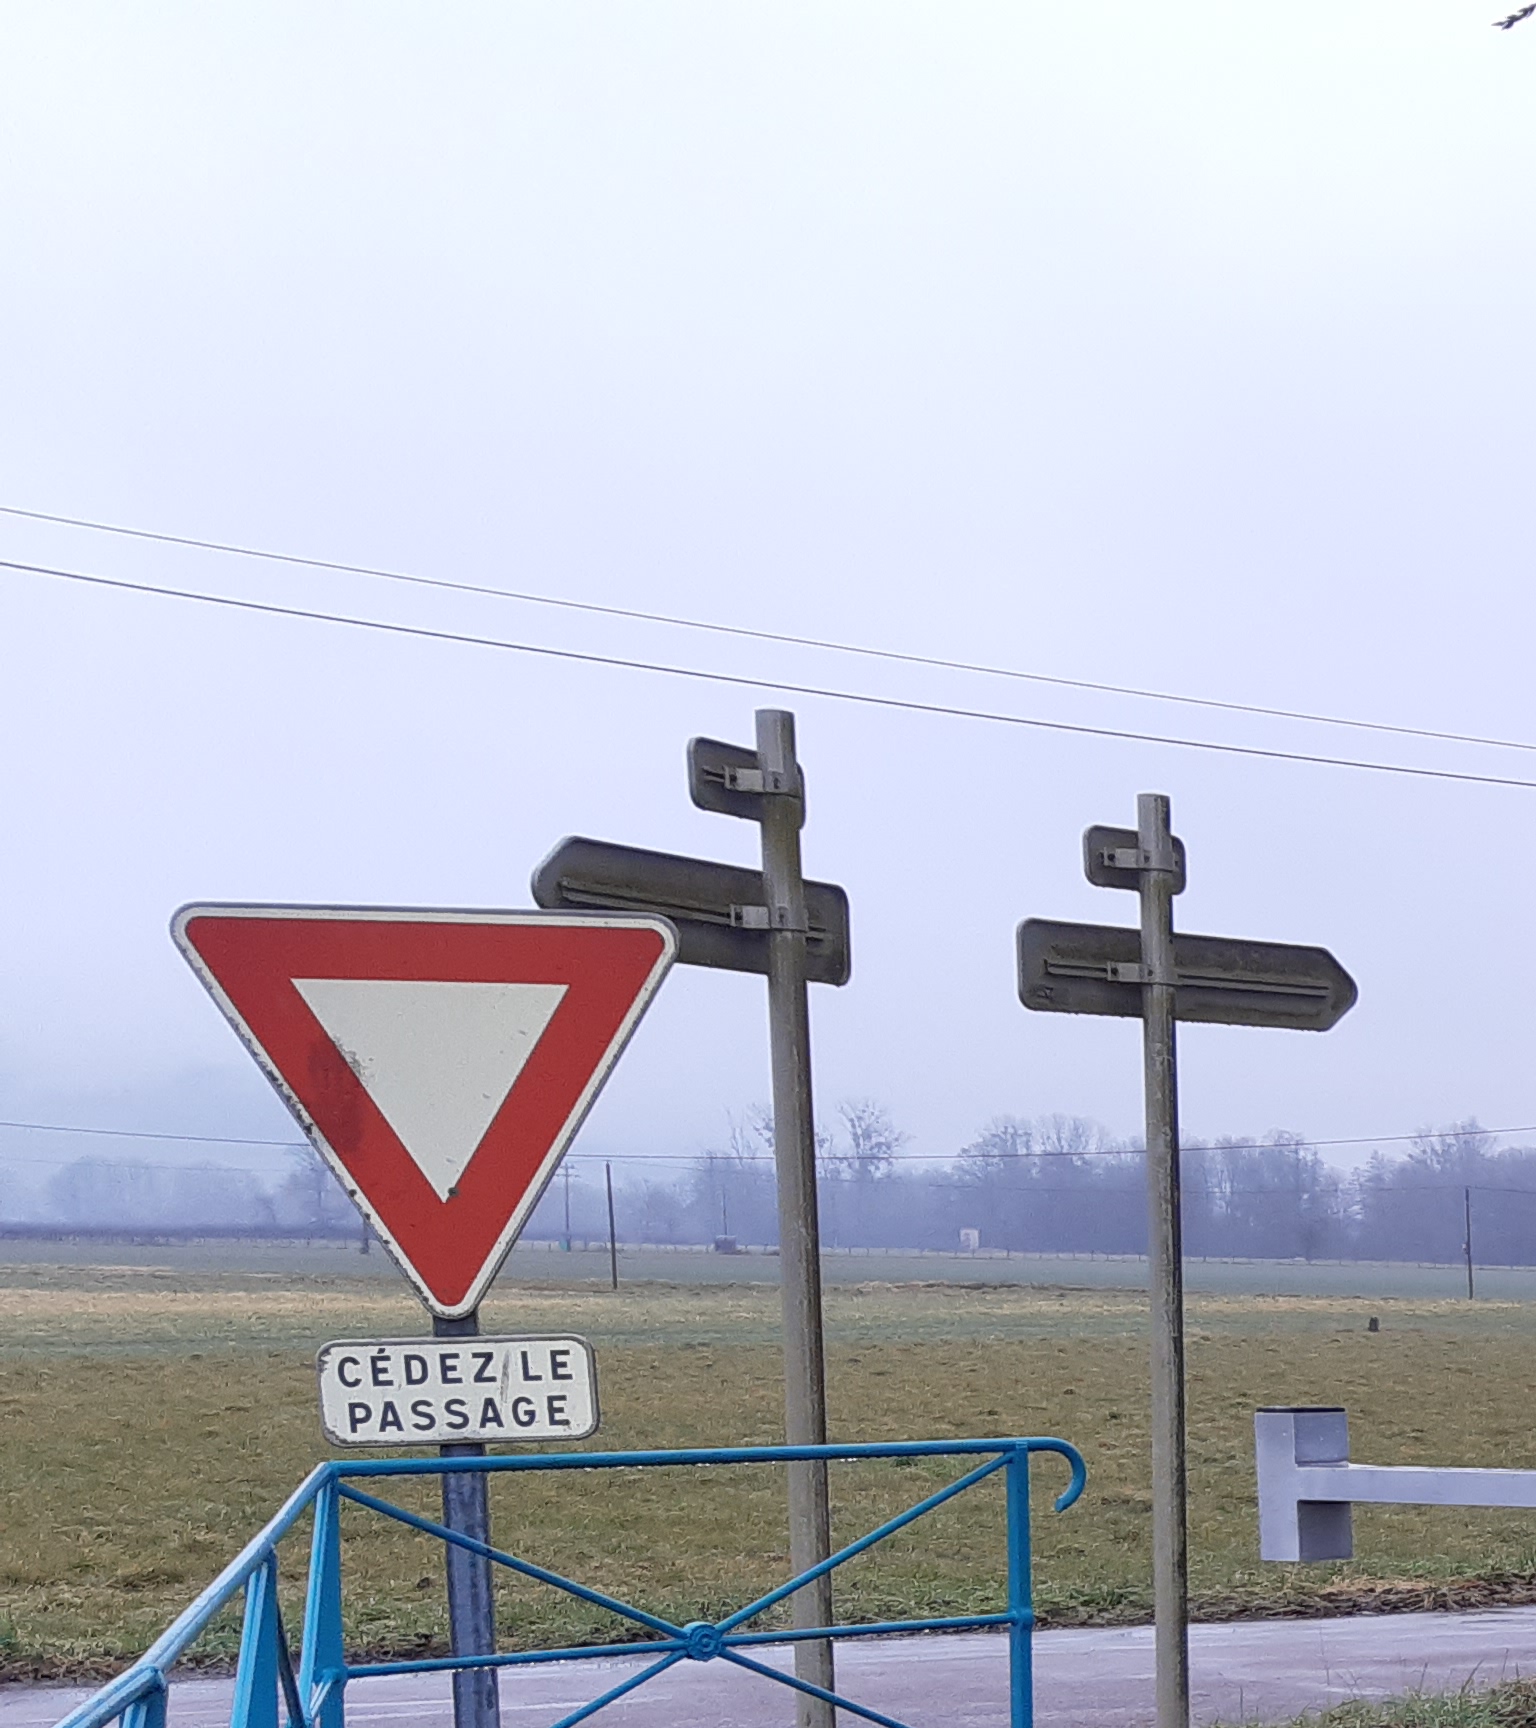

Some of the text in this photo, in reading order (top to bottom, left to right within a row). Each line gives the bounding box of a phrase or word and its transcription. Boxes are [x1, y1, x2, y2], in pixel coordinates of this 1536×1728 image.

[337, 1348, 574, 1388] CÉDEZ LE
[347, 1394, 571, 1434] PASSAGE
